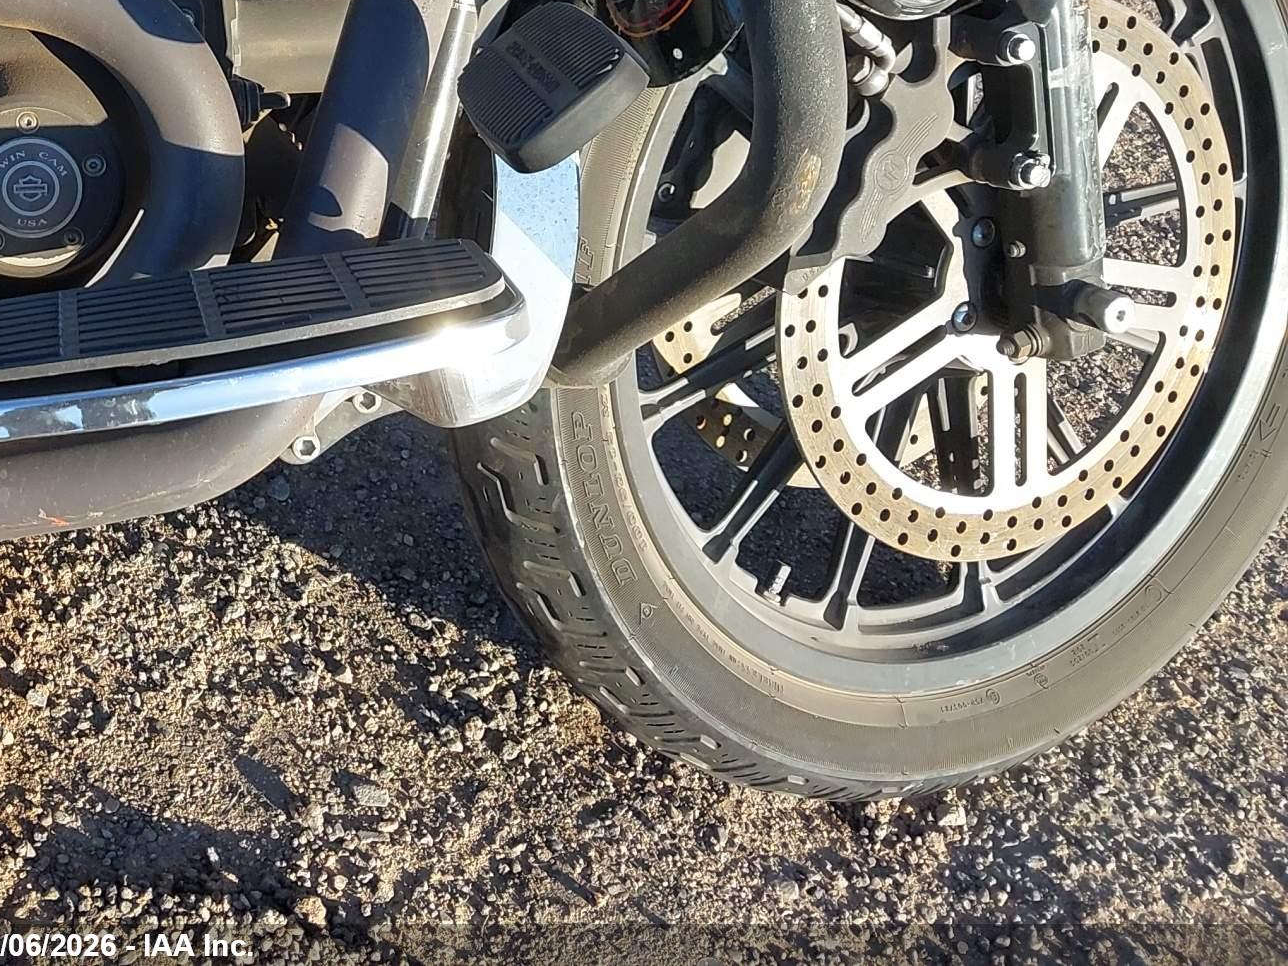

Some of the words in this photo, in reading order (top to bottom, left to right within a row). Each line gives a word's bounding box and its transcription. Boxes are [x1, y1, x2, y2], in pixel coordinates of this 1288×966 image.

[37, 151, 68, 177] CAM
[15, 218, 49, 228] USA
[570, 411, 639, 586] DUNLOP
